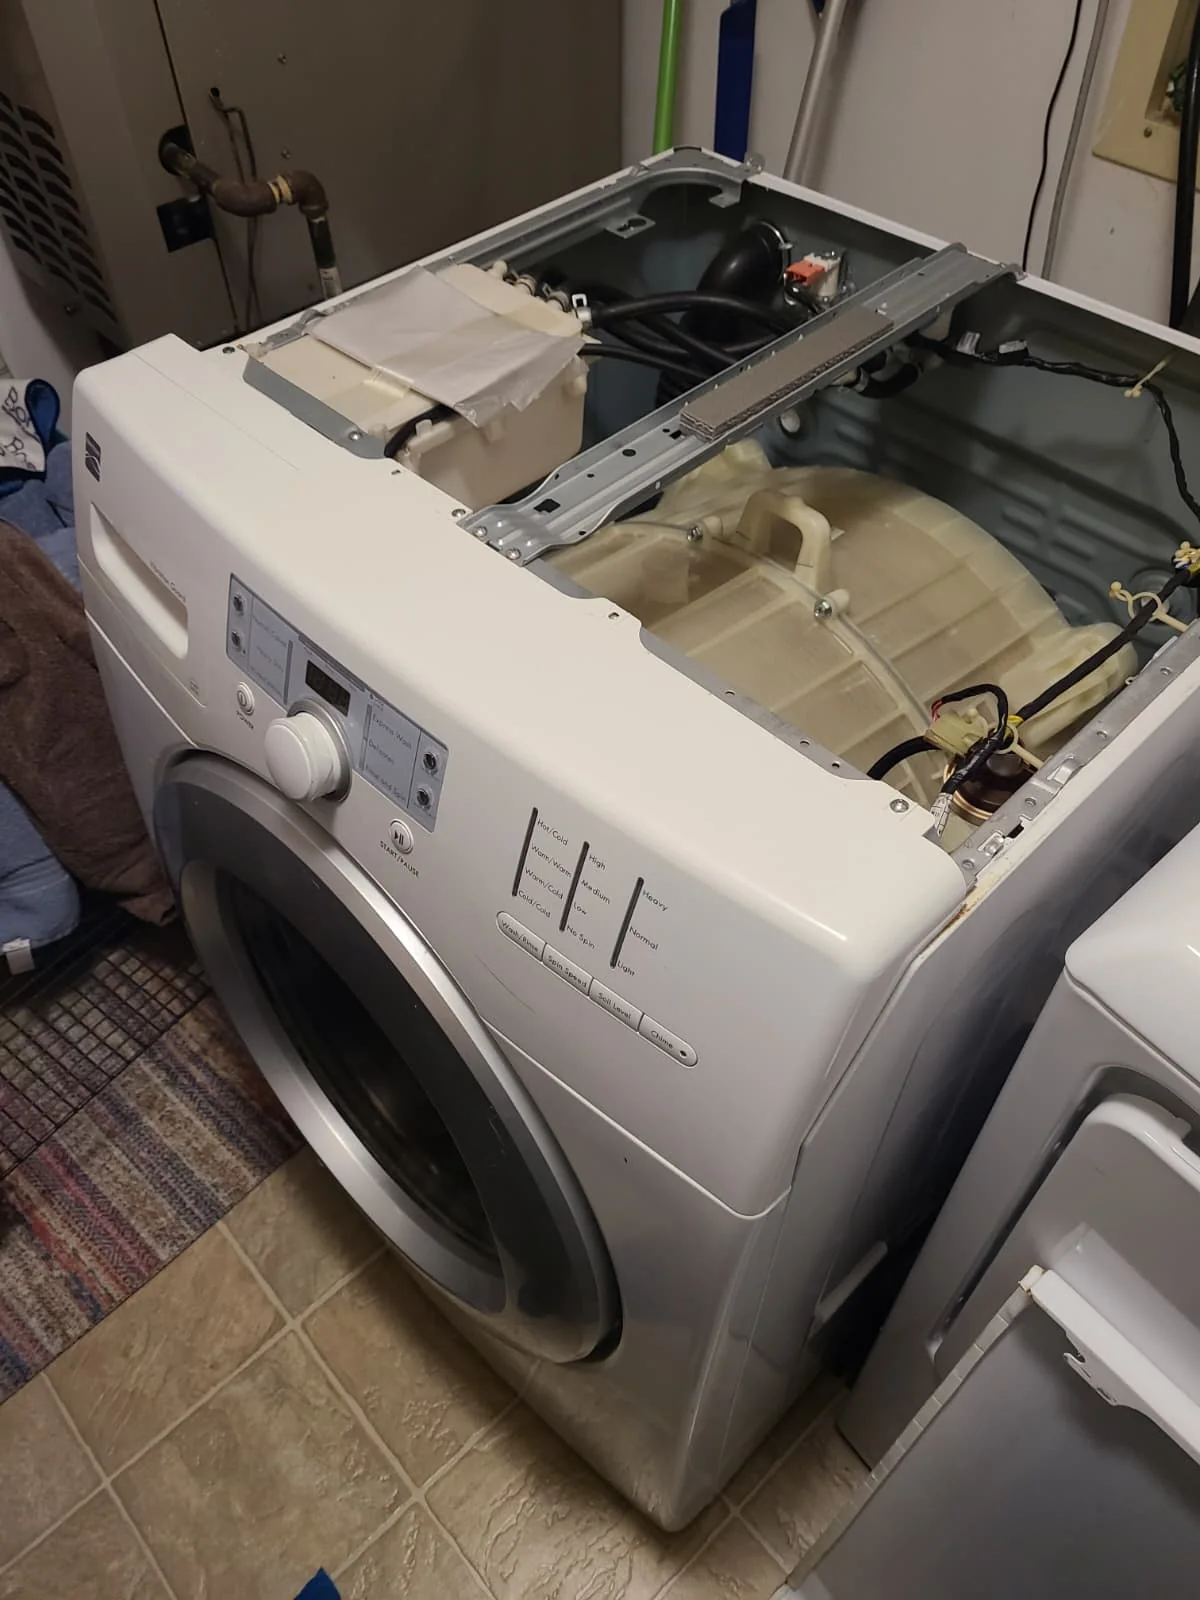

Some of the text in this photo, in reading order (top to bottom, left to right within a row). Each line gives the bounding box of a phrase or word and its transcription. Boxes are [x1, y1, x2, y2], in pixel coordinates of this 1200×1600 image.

[537, 819, 568, 846] Hot/Cold
[380, 841, 419, 877] START/PAUSE
[531, 843, 571, 878] Warm/Warm
[589, 854, 606, 870] High
[525, 866, 563, 899] Warm/Cold
[581, 879, 610, 904] Medium
[518, 890, 551, 918] Cold/Cold
[574, 902, 587, 915] Low
[642, 889, 668, 912] Heavy
[501, 919, 538, 952] Wash/Rinse
[567, 925, 595, 949] No Spin
[629, 926, 659, 950] Normal
[547, 954, 588, 988] Spin Speed
[617, 961, 635, 976] Light
[598, 992, 632, 1019] Soil Level
[650, 1030, 674, 1049] Chime
